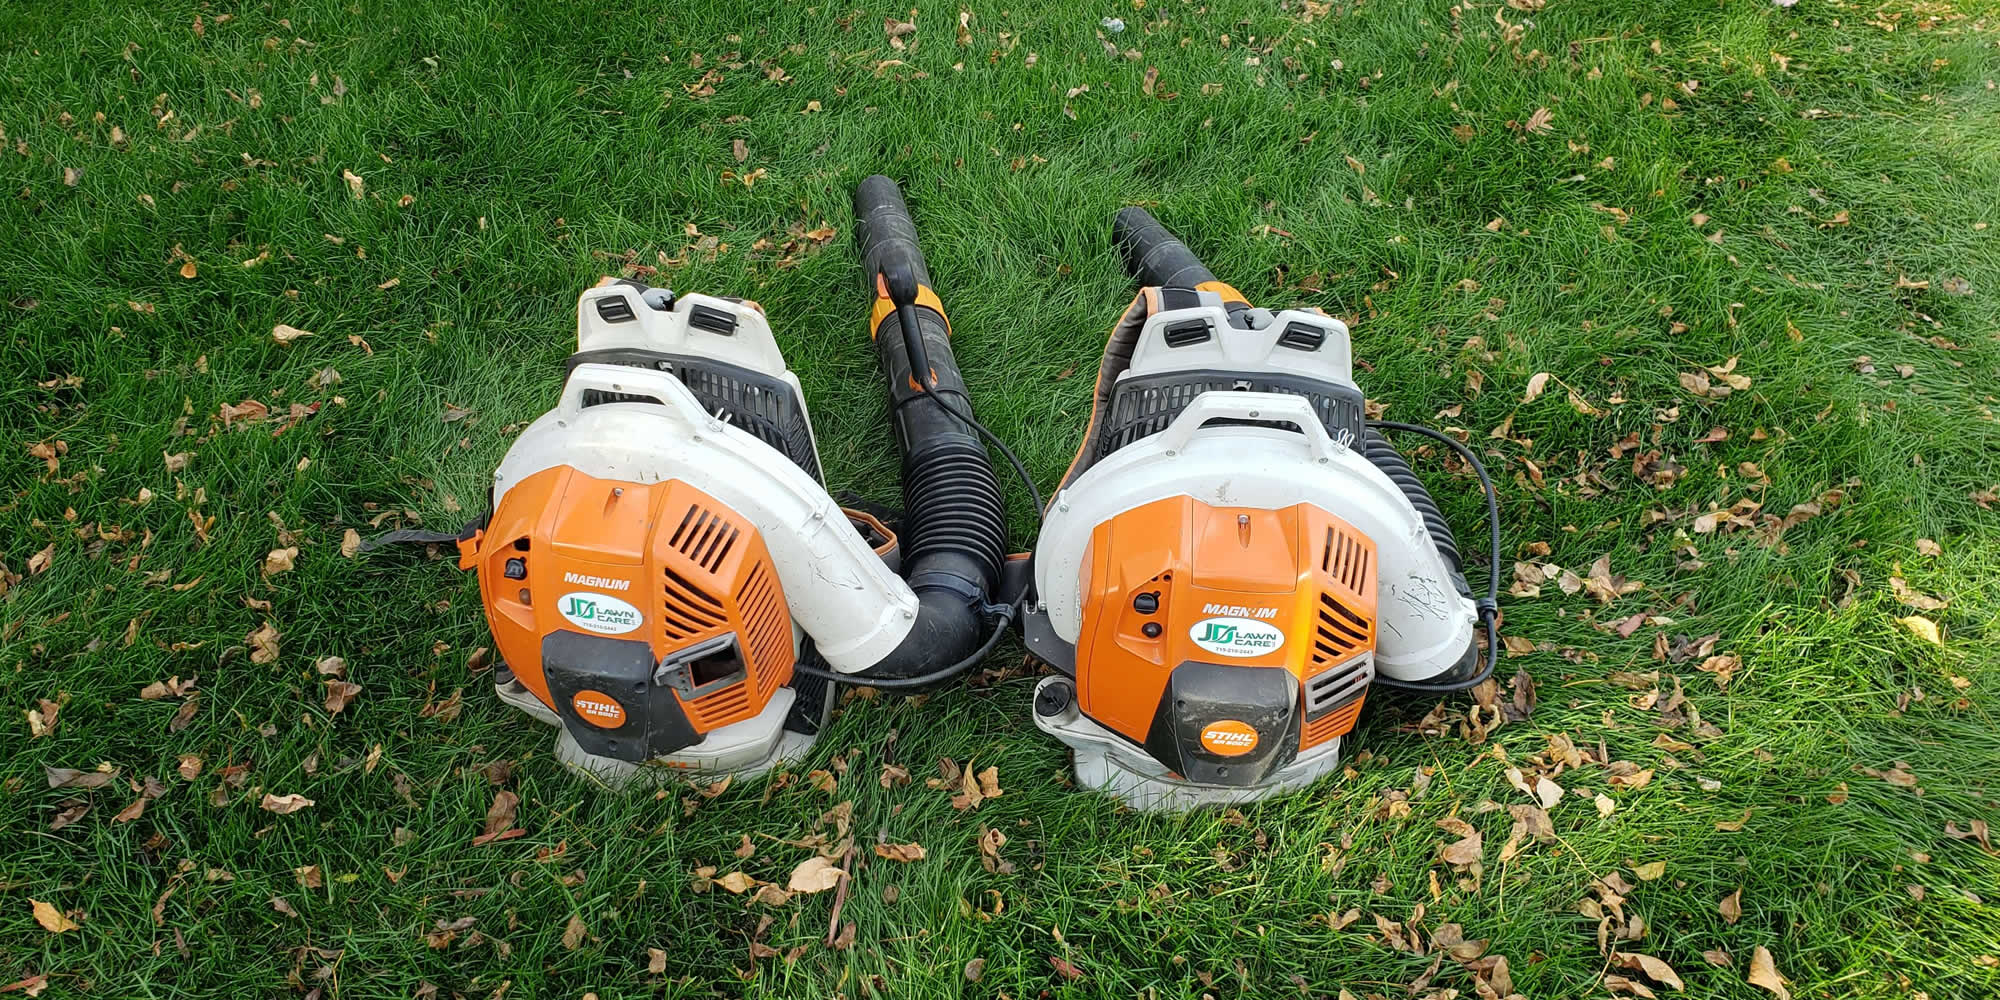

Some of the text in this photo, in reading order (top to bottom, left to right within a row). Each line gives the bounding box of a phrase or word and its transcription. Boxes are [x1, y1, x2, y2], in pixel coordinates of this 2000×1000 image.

[564, 572, 630, 591] MAGNUM
[596, 607, 634, 618] LAWN
[597, 615, 631, 625] CARE
[1236, 631, 1276, 640] LAWN
[1234, 639, 1271, 647] CARE
[576, 700, 620, 714] STIHL
[1204, 731, 1254, 742] STIHL
